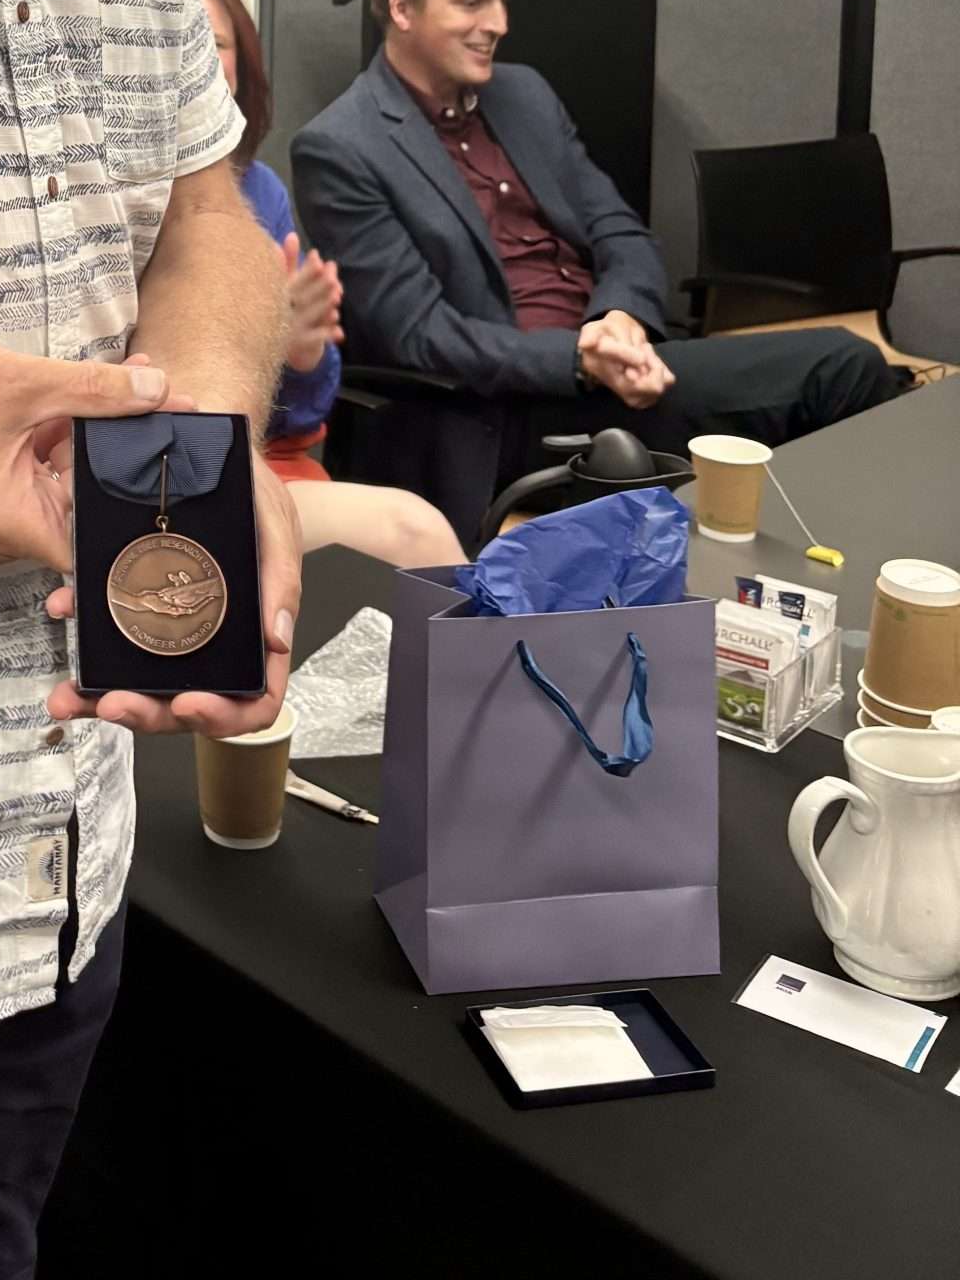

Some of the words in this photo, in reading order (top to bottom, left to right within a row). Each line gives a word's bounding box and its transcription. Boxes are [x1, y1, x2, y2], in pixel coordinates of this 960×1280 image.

[130, 624, 177, 649] PIONEER
[180, 621, 212, 647] AWARD
[717, 628, 774, 651] RCHALL
[53, 839, 63, 895] MANTARAY
